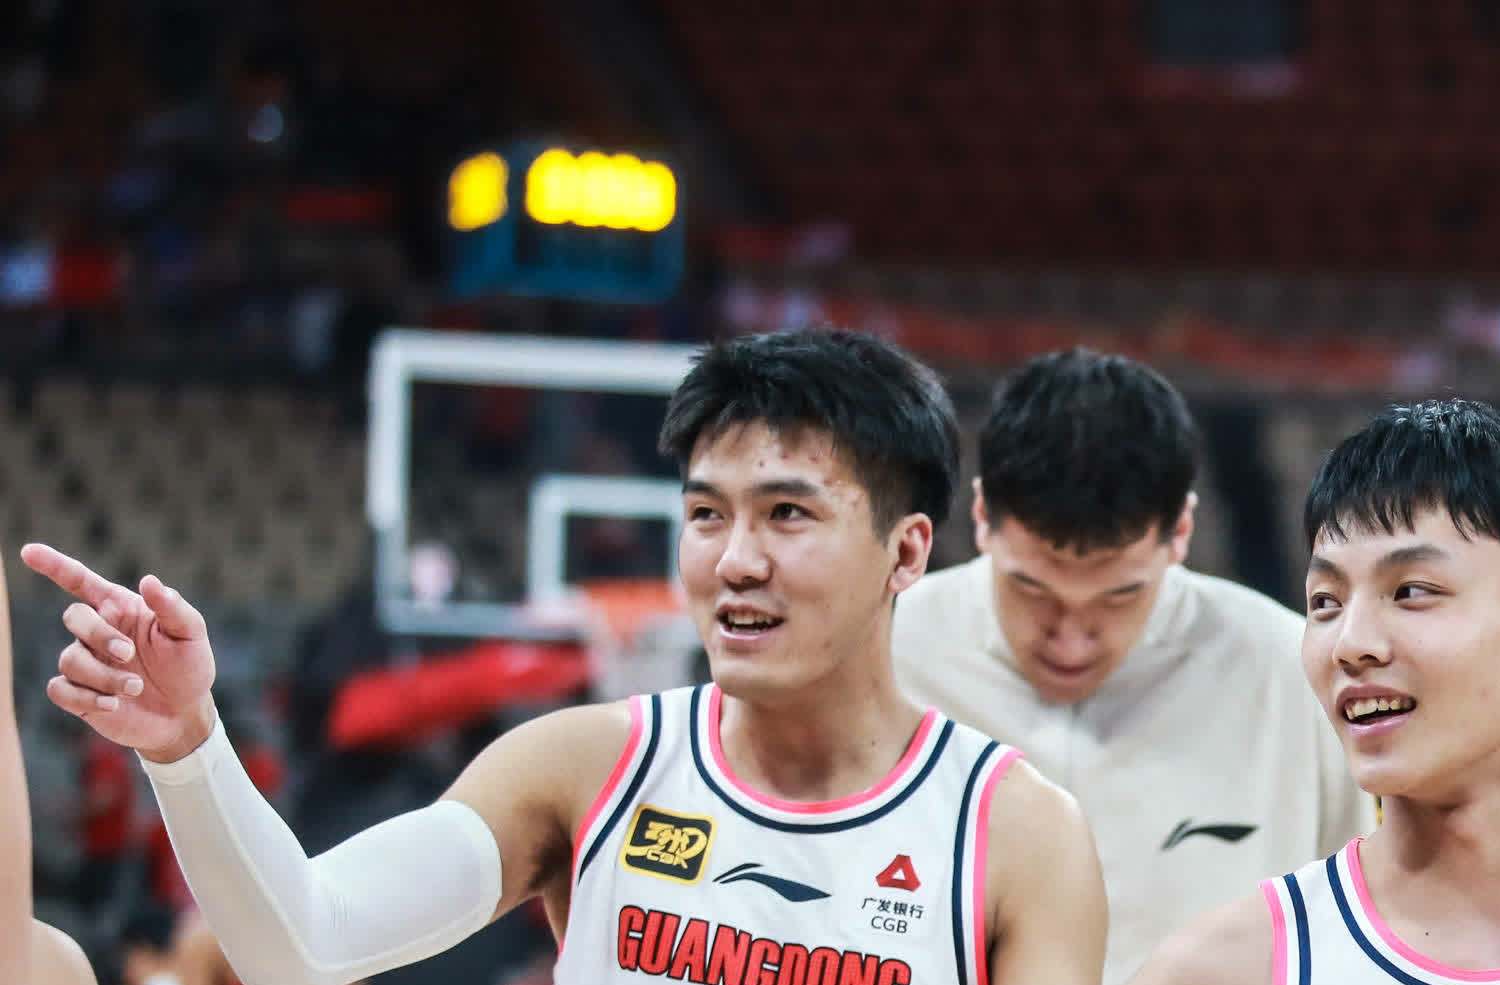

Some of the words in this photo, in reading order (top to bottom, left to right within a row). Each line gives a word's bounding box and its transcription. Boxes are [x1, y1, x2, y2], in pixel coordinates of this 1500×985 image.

[861, 896, 925, 920] 广发银行
[870, 915, 909, 934] CGB
